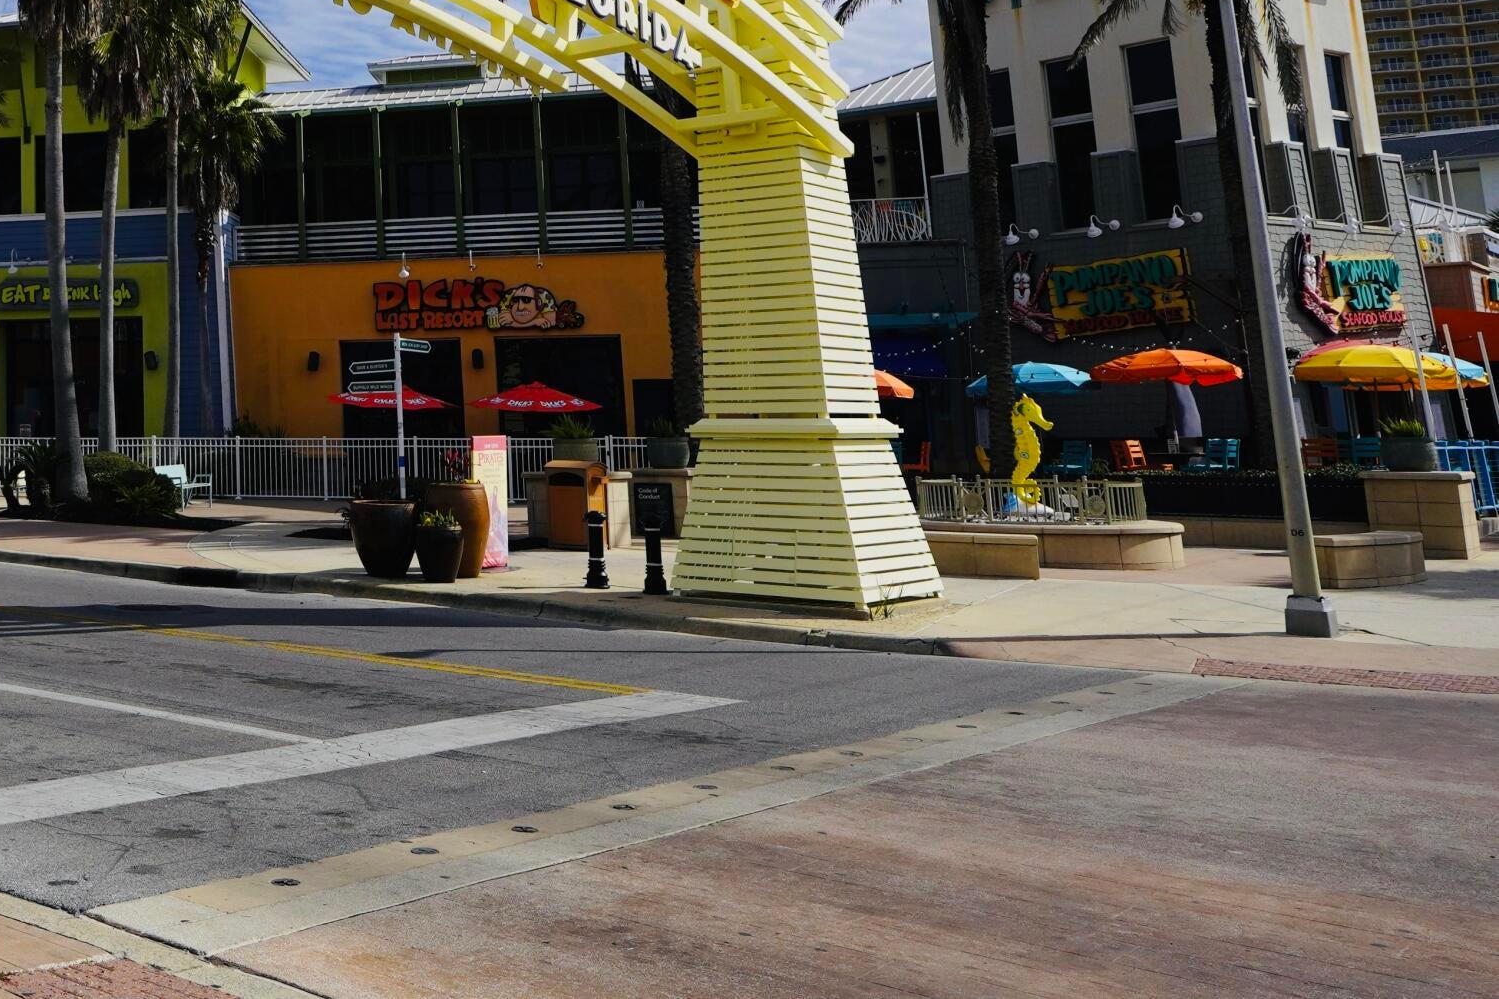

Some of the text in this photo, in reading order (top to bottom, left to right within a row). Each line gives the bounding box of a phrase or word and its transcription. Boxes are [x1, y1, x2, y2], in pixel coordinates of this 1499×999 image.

[1049, 254, 1177, 308] POMPANO
[1328, 258, 1403, 299] POMPANO
[1, 282, 132, 306] EAT DINK lgh
[373, 277, 504, 311] DICK'S
[376, 309, 484, 330] LAST RESORT
[1341, 311, 1378, 327] SEAFOOD
